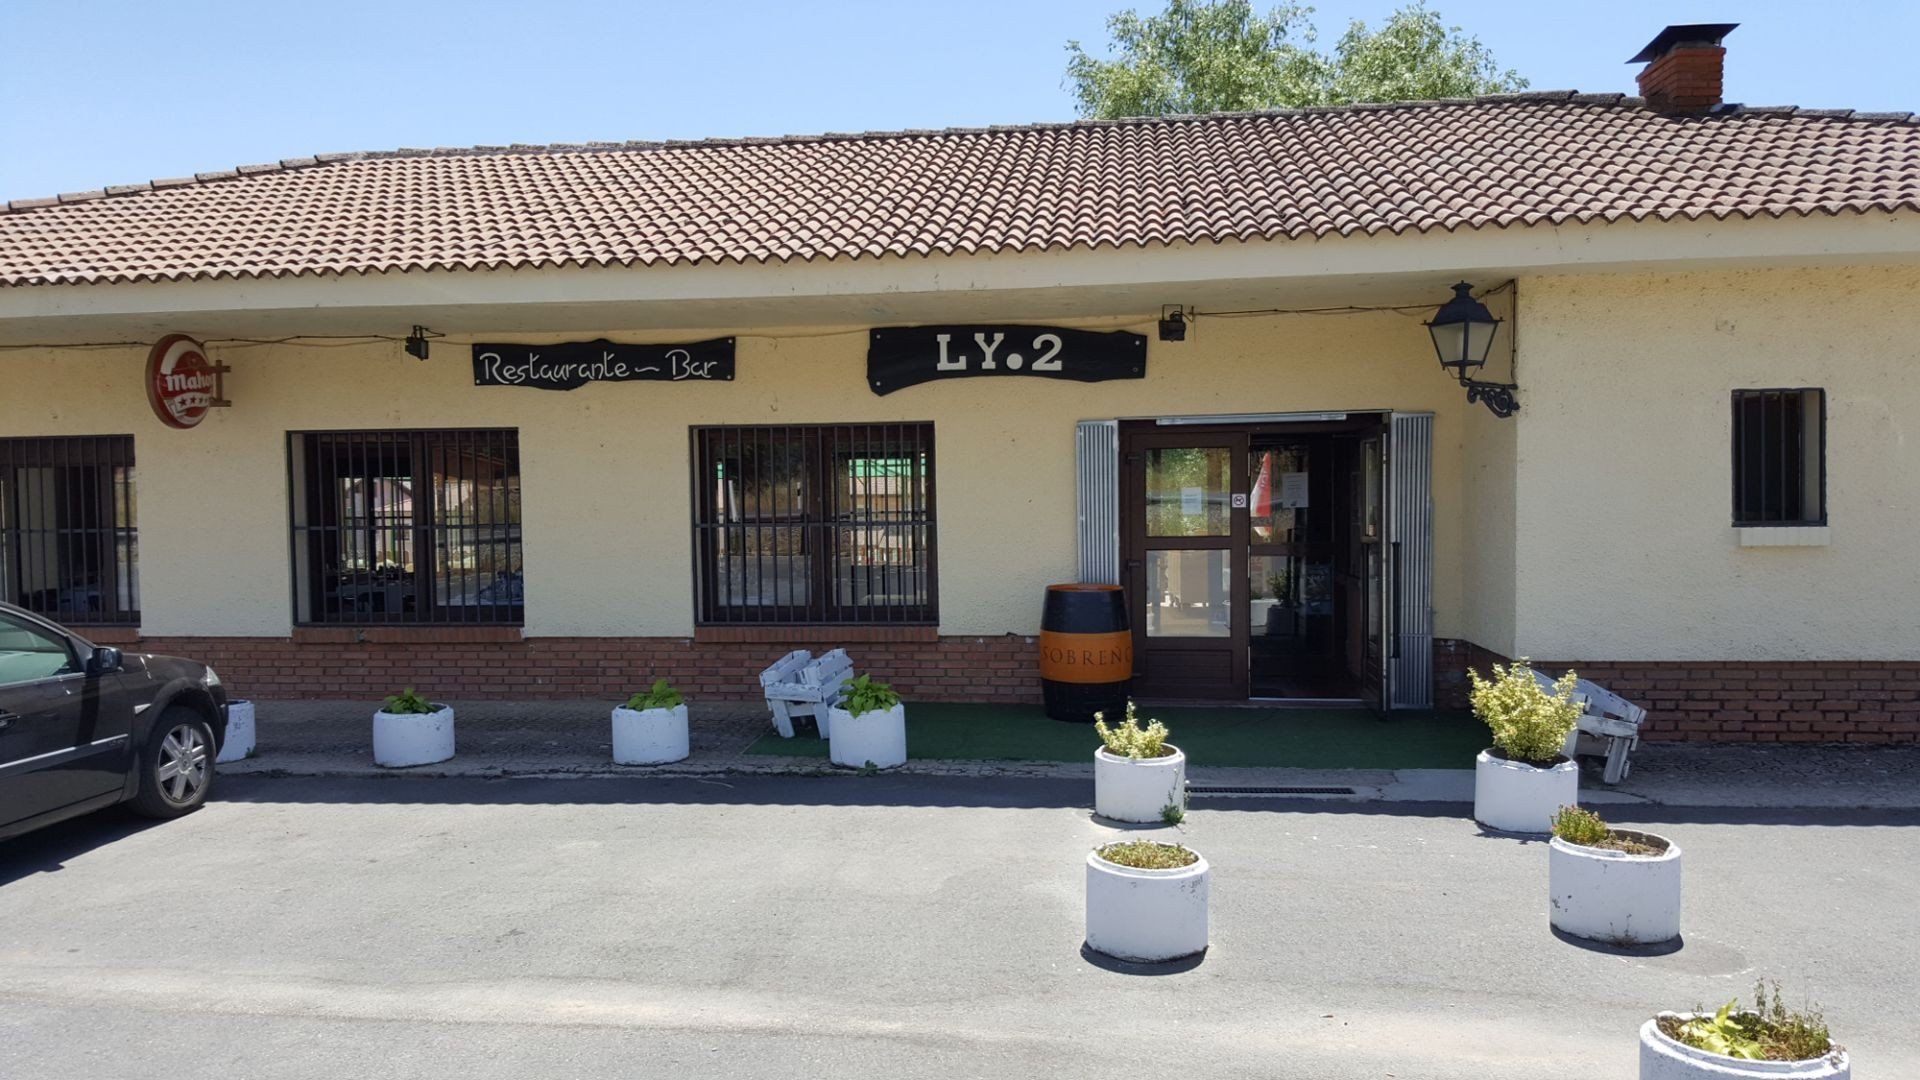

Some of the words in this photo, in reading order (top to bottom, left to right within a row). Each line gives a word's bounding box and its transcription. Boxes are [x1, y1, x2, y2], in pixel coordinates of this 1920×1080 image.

[480, 350, 630, 384] Restaurante
[665, 349, 718, 380] Bar
[936, 333, 1062, 371] LY.2
[165, 371, 213, 391] Maho
